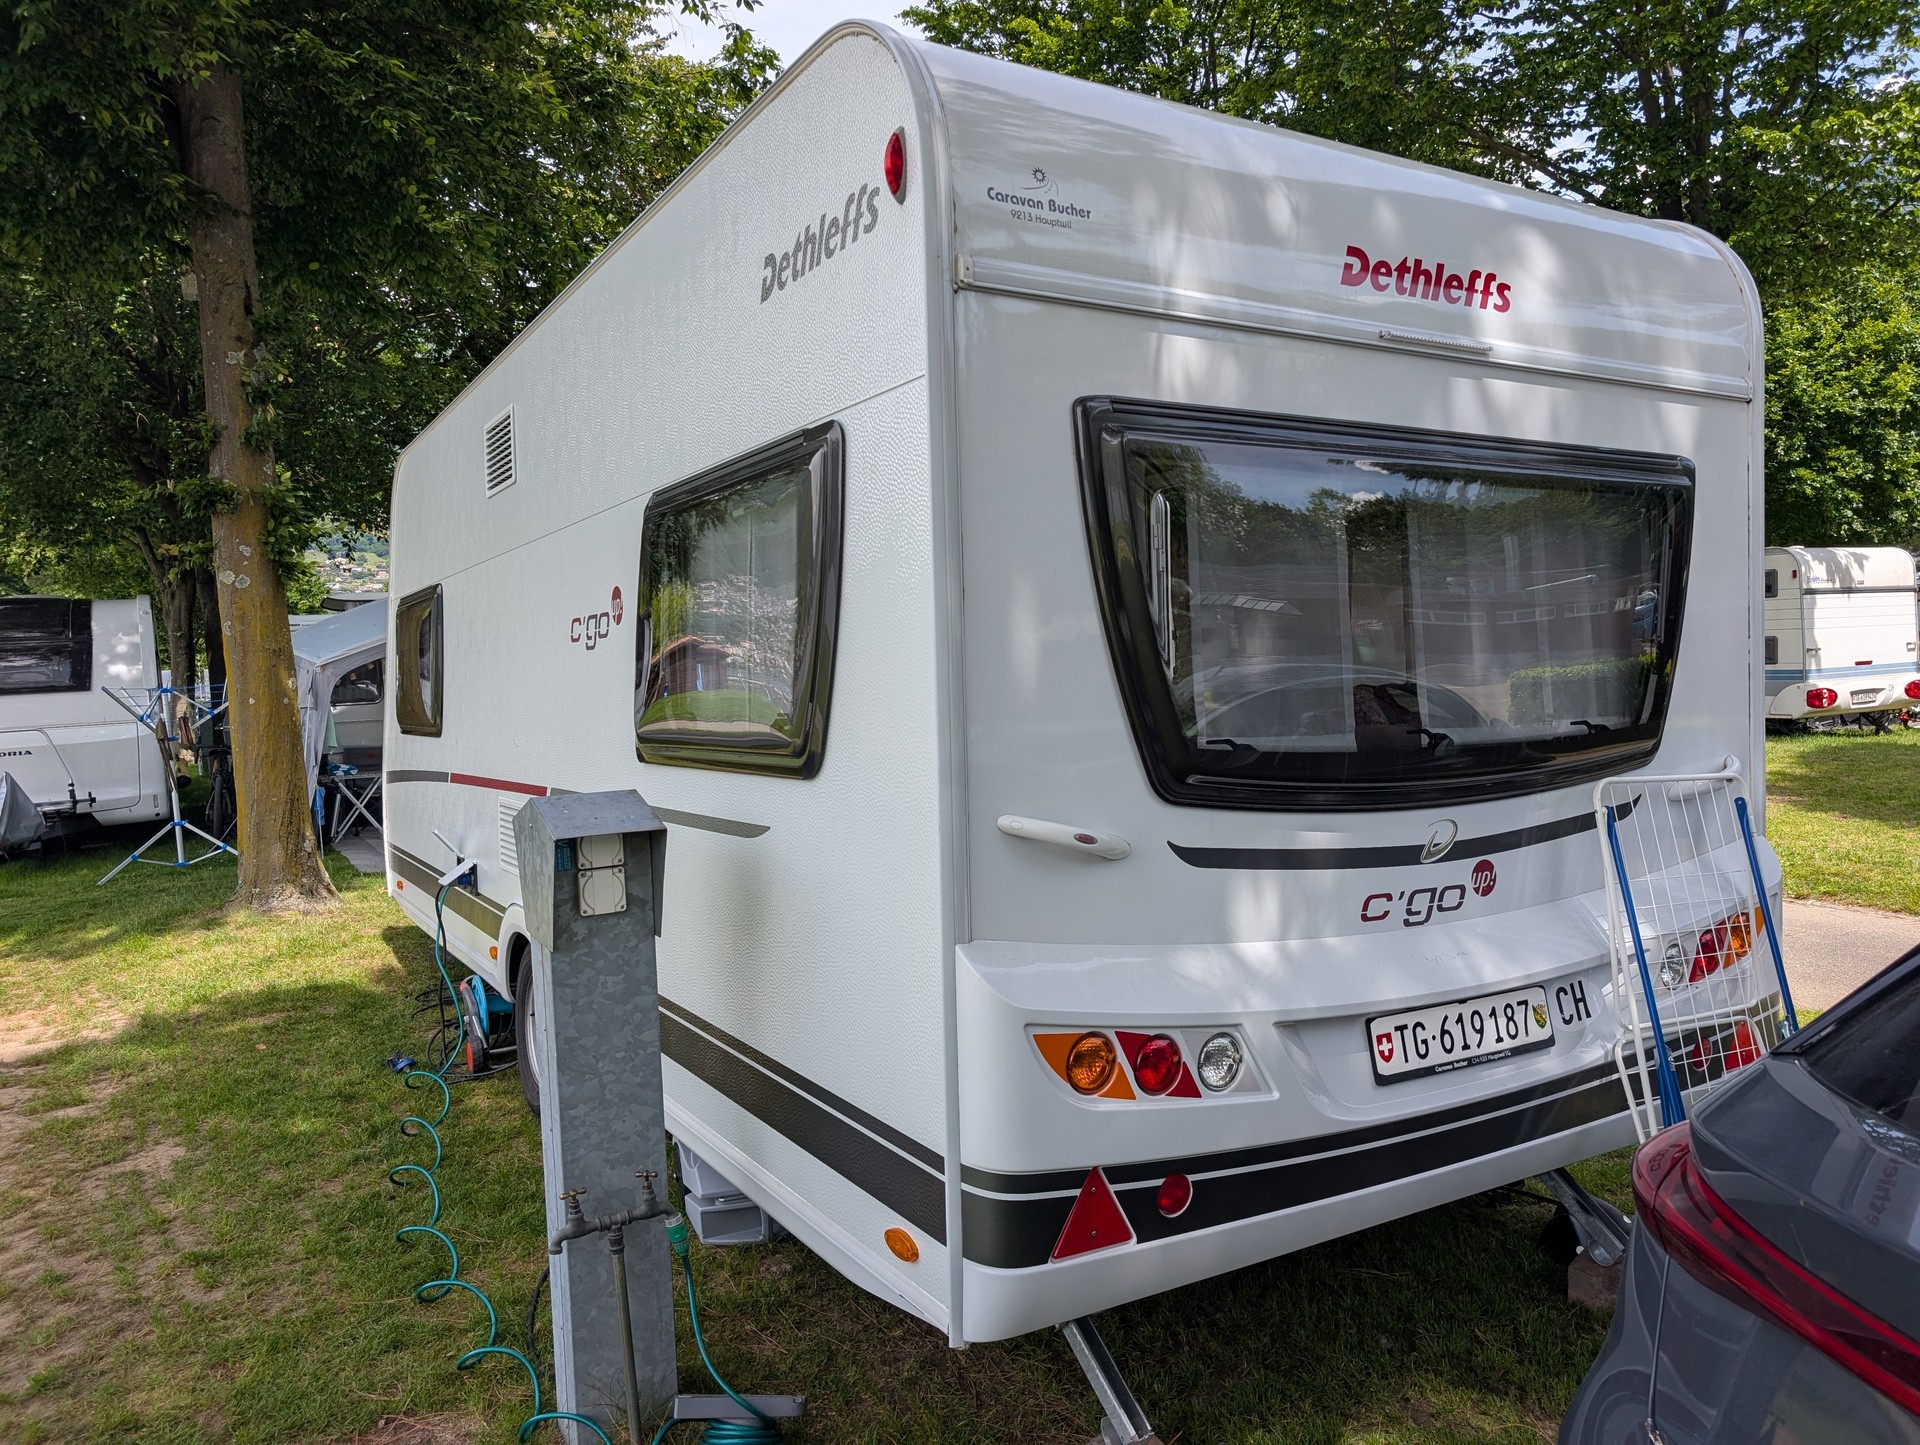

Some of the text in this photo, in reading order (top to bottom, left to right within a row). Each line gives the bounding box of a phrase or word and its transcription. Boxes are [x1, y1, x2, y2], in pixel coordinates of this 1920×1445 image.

[987, 186, 1091, 219] Caravan Bucher
[1010, 209, 1072, 229] 9213 Hauptwil
[760, 182, 880, 305] Dethleffs
[1340, 245, 1511, 313] Dethleffs
[1360, 866, 1497, 927] c'go up!
[1555, 980, 1592, 1026] CH
